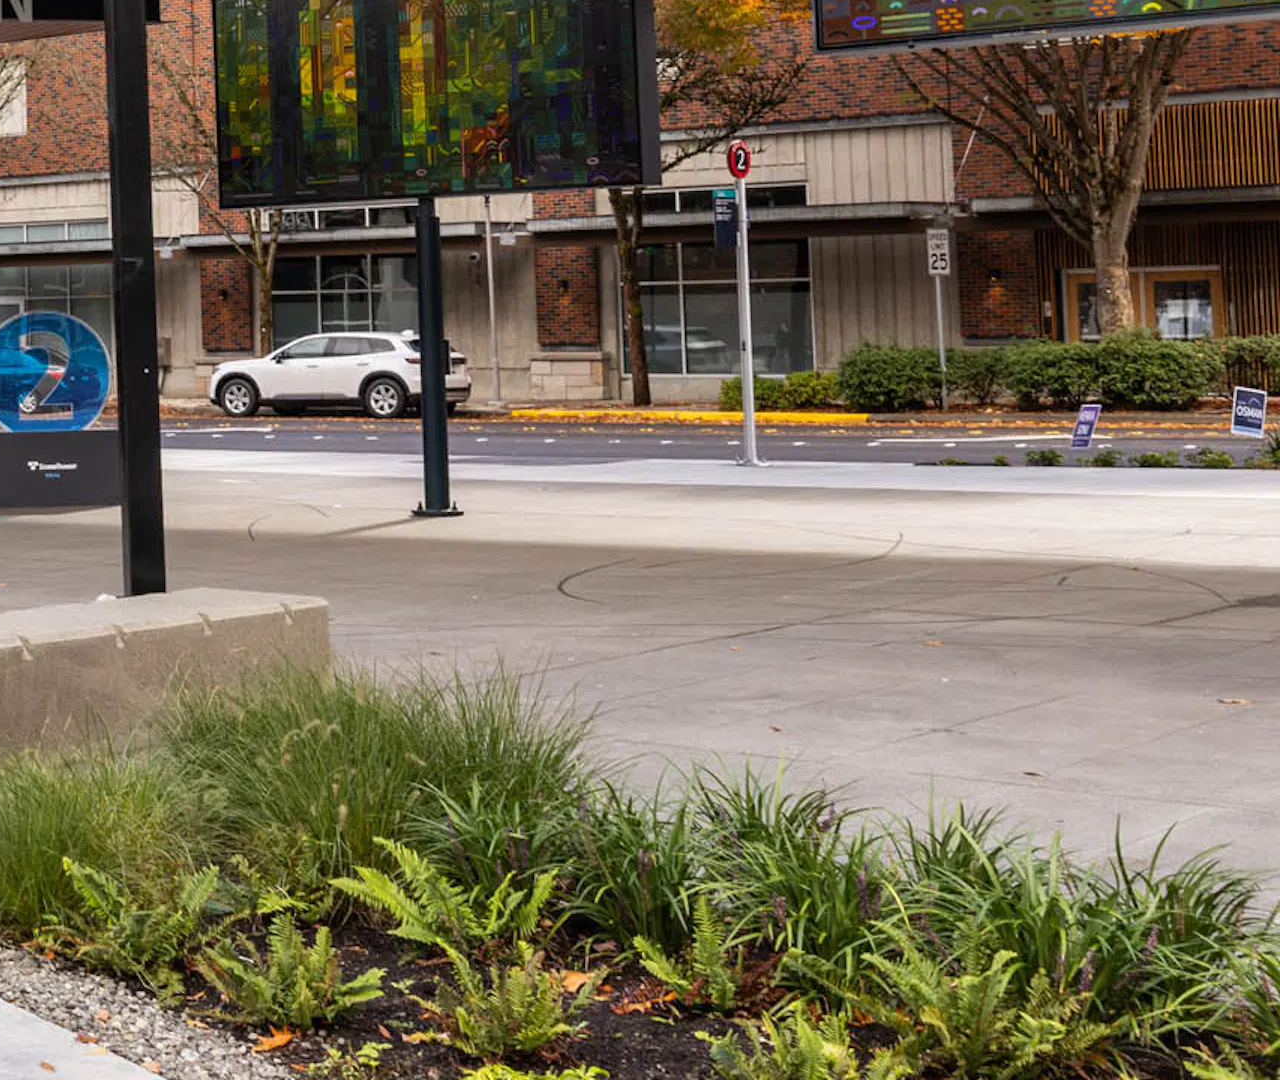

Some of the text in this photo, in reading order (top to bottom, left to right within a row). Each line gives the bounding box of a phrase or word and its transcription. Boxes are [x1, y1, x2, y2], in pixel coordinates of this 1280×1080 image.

[736, 149, 745, 170] 2
[931, 253, 948, 270] 25
[19, 330, 74, 420] 2
